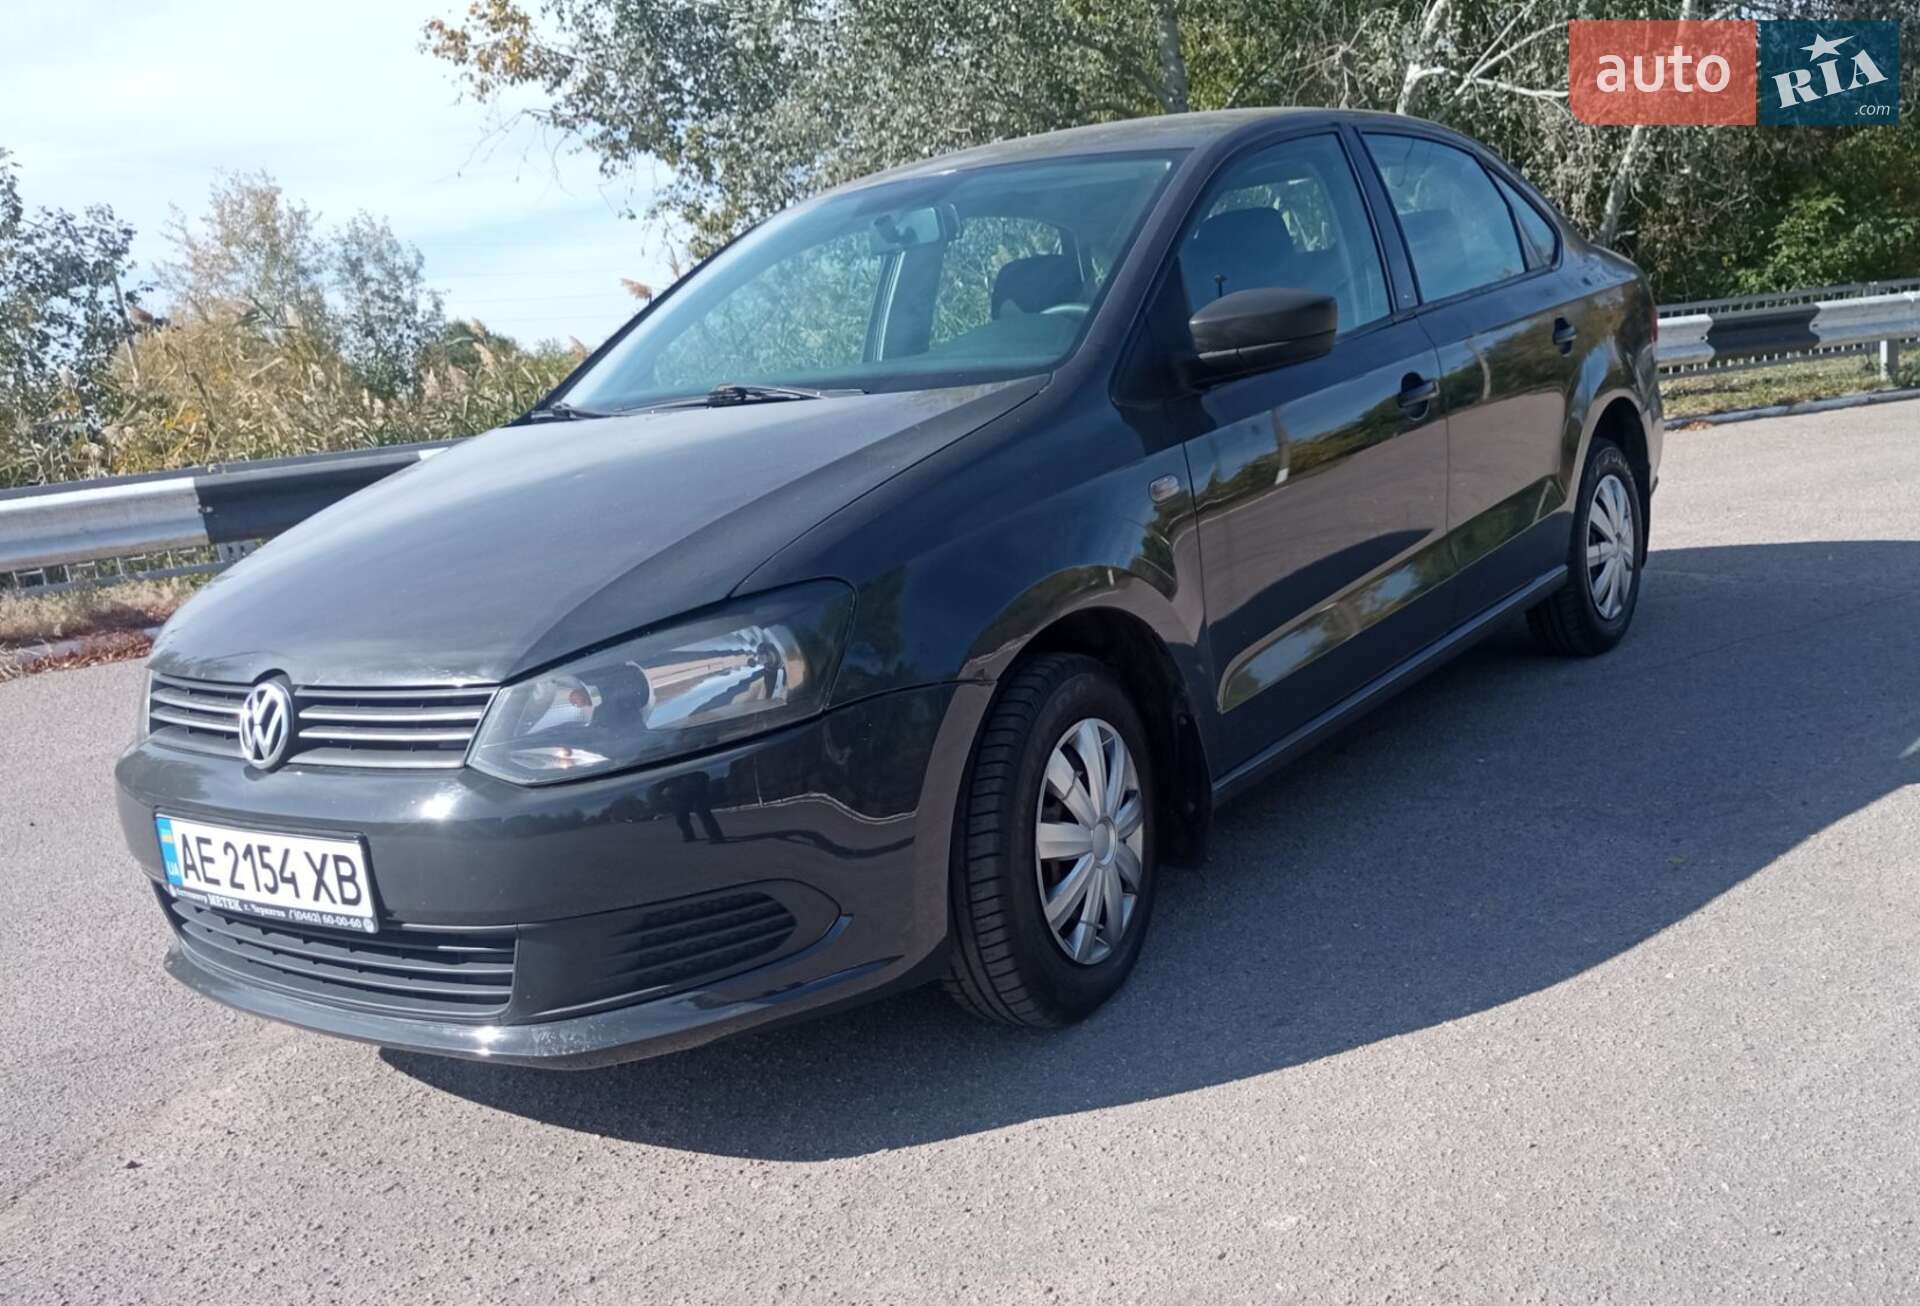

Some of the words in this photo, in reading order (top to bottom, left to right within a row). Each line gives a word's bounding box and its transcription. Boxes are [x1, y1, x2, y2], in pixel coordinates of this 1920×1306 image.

[166, 862, 180, 877] UA
[181, 833, 220, 886] AE
[223, 841, 300, 899] 2154
[304, 850, 362, 906] XB
